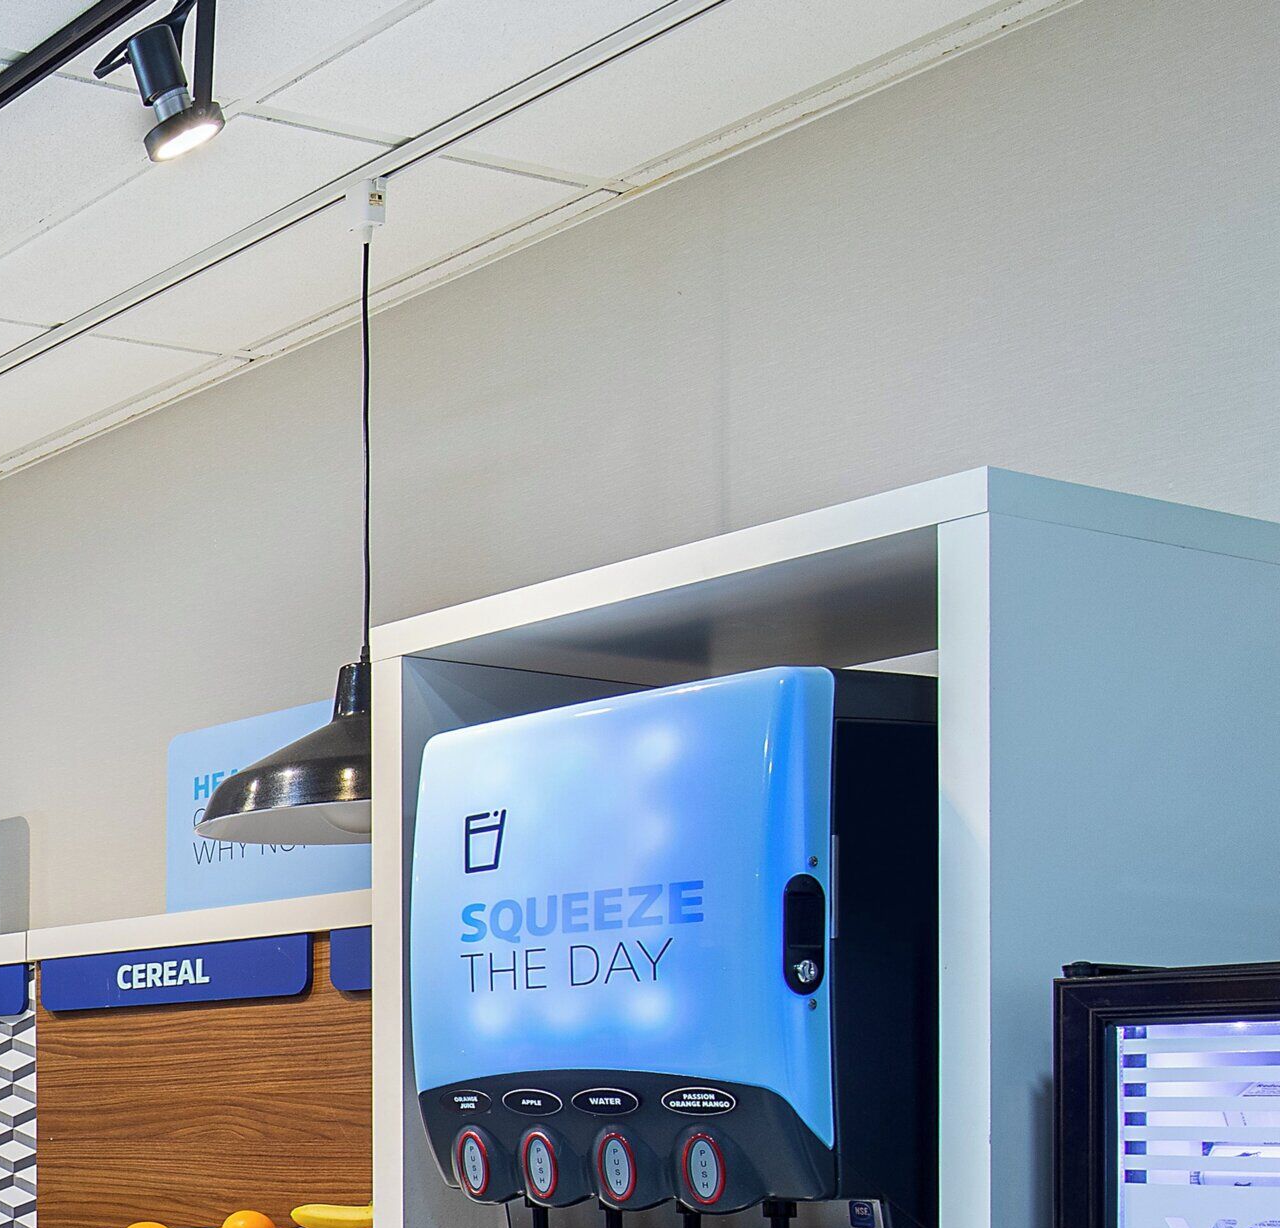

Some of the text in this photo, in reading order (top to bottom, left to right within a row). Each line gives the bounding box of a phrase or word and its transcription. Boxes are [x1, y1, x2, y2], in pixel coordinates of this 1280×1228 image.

[460, 880, 705, 944] SQUEEZE
[117, 958, 210, 990] CEREAL
[460, 937, 674, 993] THE DAY
[589, 1097, 621, 1106] WATER
[669, 1099, 730, 1108] ORANGE MANGO
[470, 1146, 478, 1181] PUSH
[536, 1148, 545, 1183] PUSH
[613, 1149, 622, 1186] PUSH
[700, 1150, 709, 1188] PUSH
